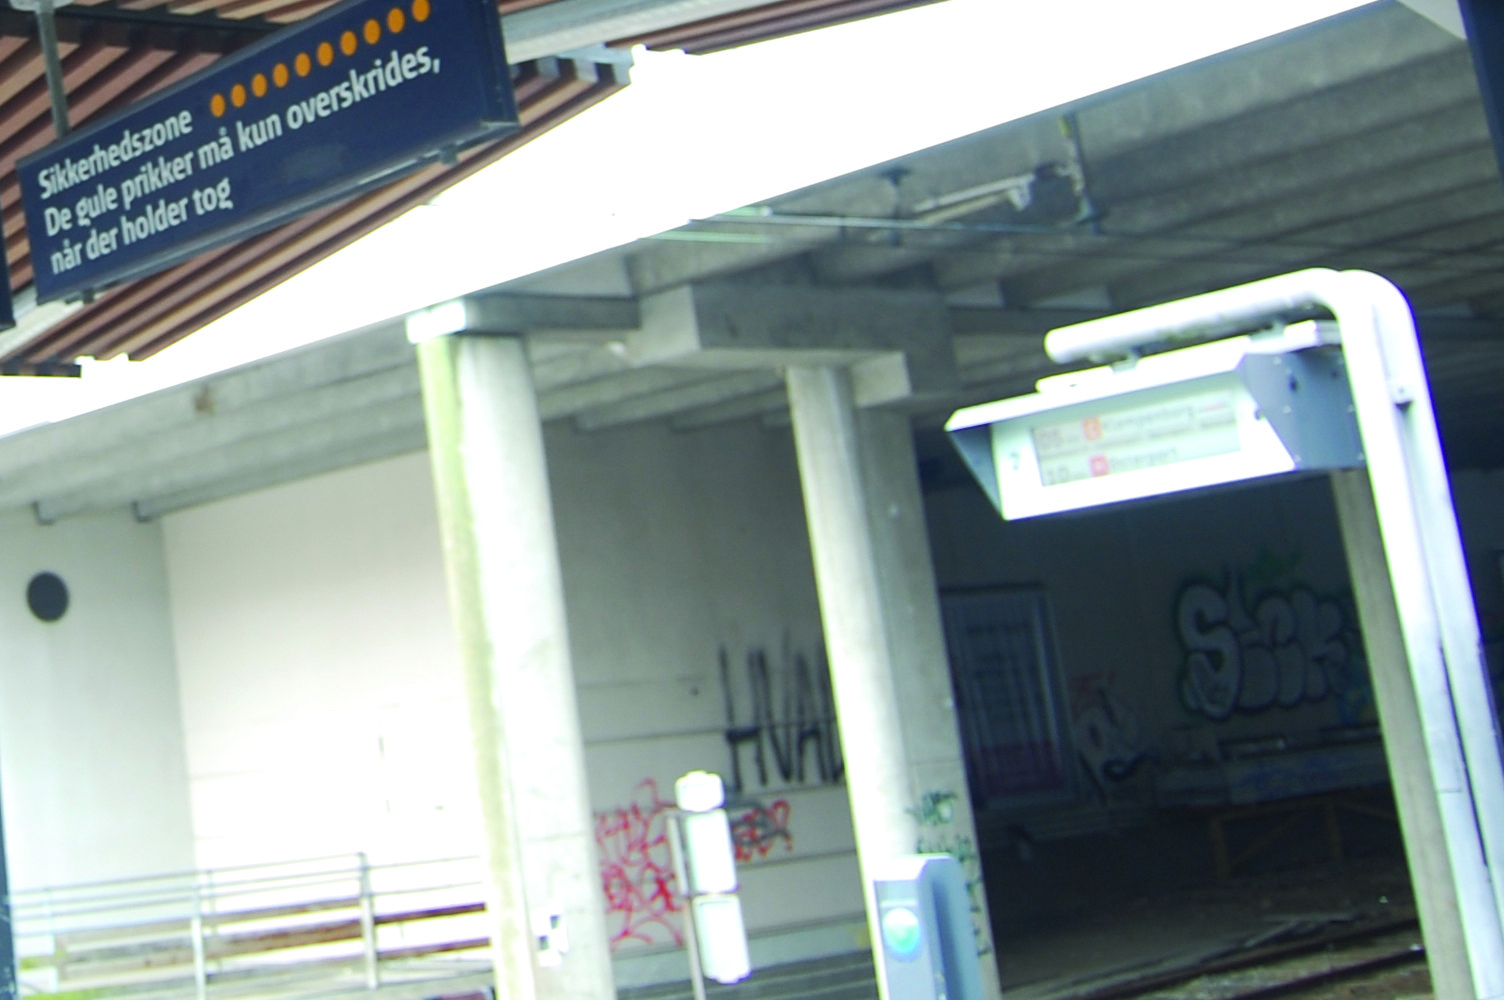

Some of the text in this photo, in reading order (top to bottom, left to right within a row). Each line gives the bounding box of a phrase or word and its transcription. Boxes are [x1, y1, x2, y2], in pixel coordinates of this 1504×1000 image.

[37, 109, 193, 200] Sikkerhedszone
[44, 46, 441, 237] De gule prikker må kun overskrides,
[50, 176, 234, 276] når der holder tog
